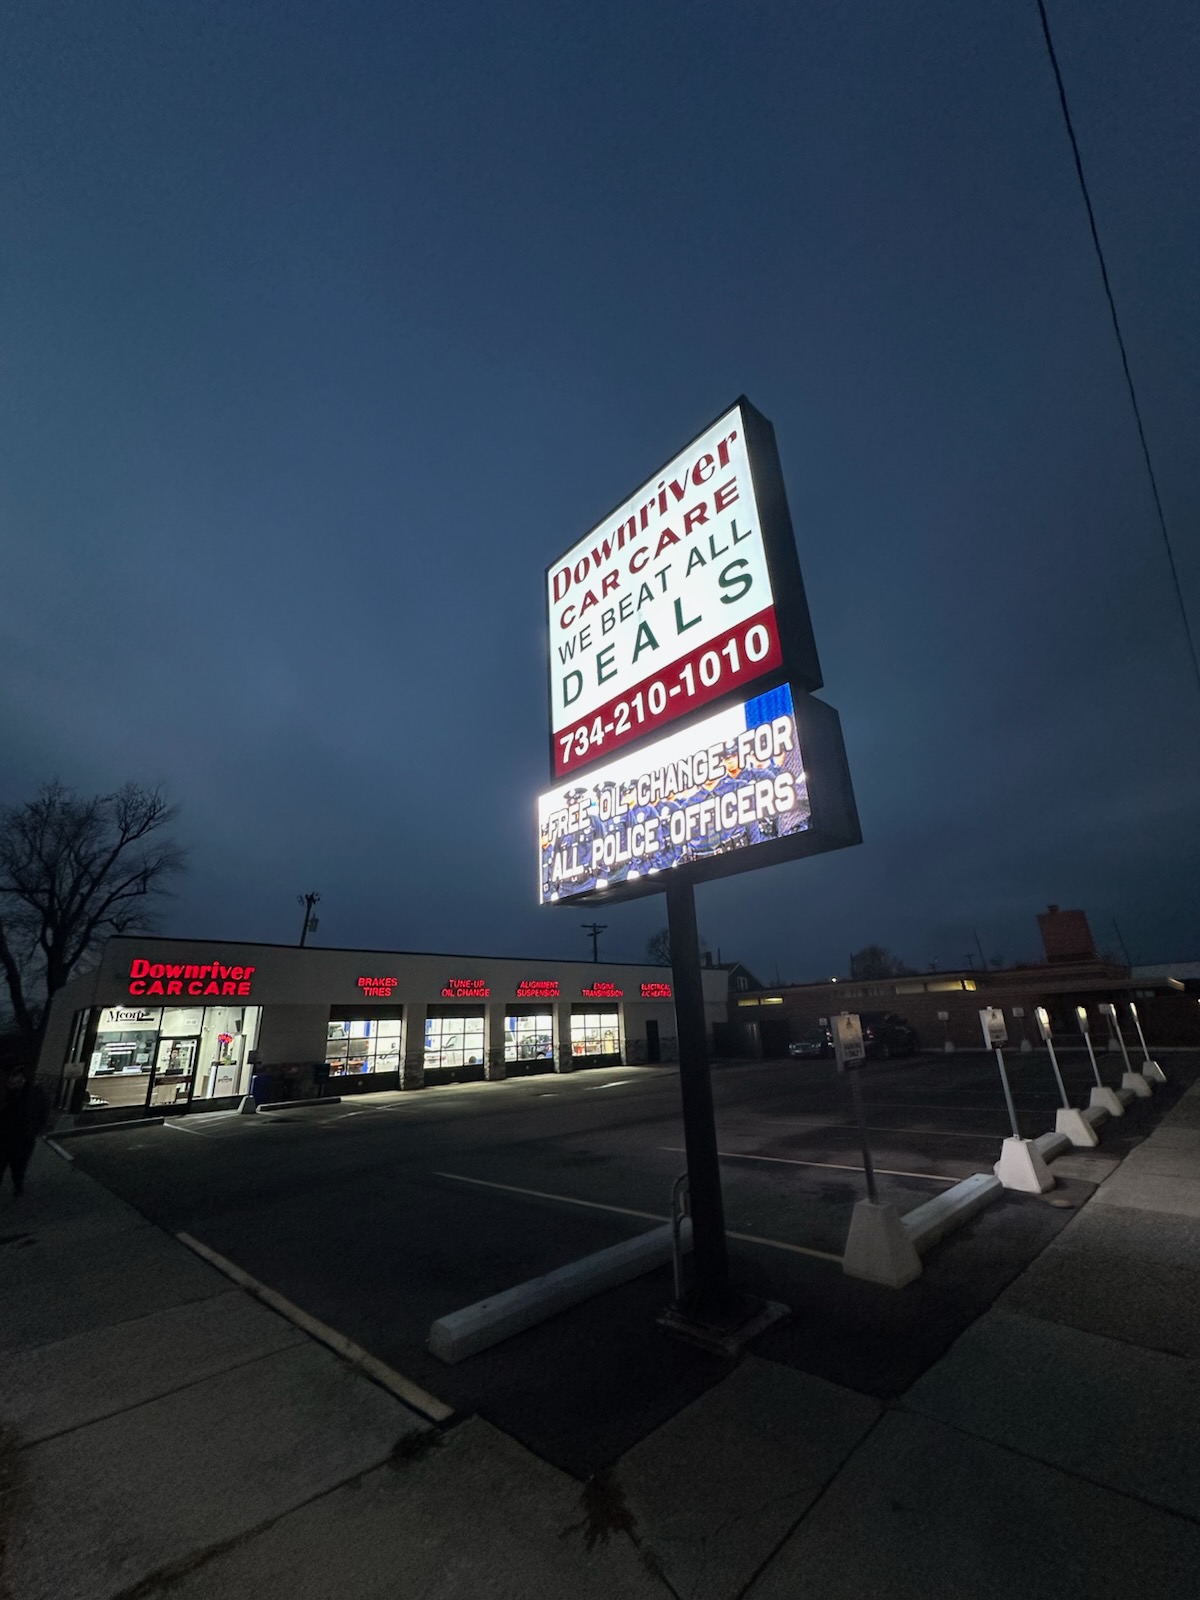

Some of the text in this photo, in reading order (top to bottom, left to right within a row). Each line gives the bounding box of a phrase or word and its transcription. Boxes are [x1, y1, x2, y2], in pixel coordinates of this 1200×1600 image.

[553, 430, 738, 605] Downriver
[559, 476, 740, 630] CAR CARE
[558, 518, 753, 665] WE BEAT ALL
[563, 557, 754, 709] DEALS
[559, 623, 770, 764] 734-210-1010
[547, 715, 794, 843] FREE OIL CHANGE FOR
[552, 772, 797, 883] ALL POLICE OFFICERS
[130, 959, 255, 980] Downriver
[129, 981, 251, 996] CAR CARE
[357, 977, 398, 987] BRAKES
[363, 987, 392, 997] TIRES
[441, 988, 490, 997] OIL CHANGE
[449, 980, 485, 988] TUNE-UP
[520, 981, 559, 989] ALIGNMENT
[517, 989, 559, 997] SUSPENSION
